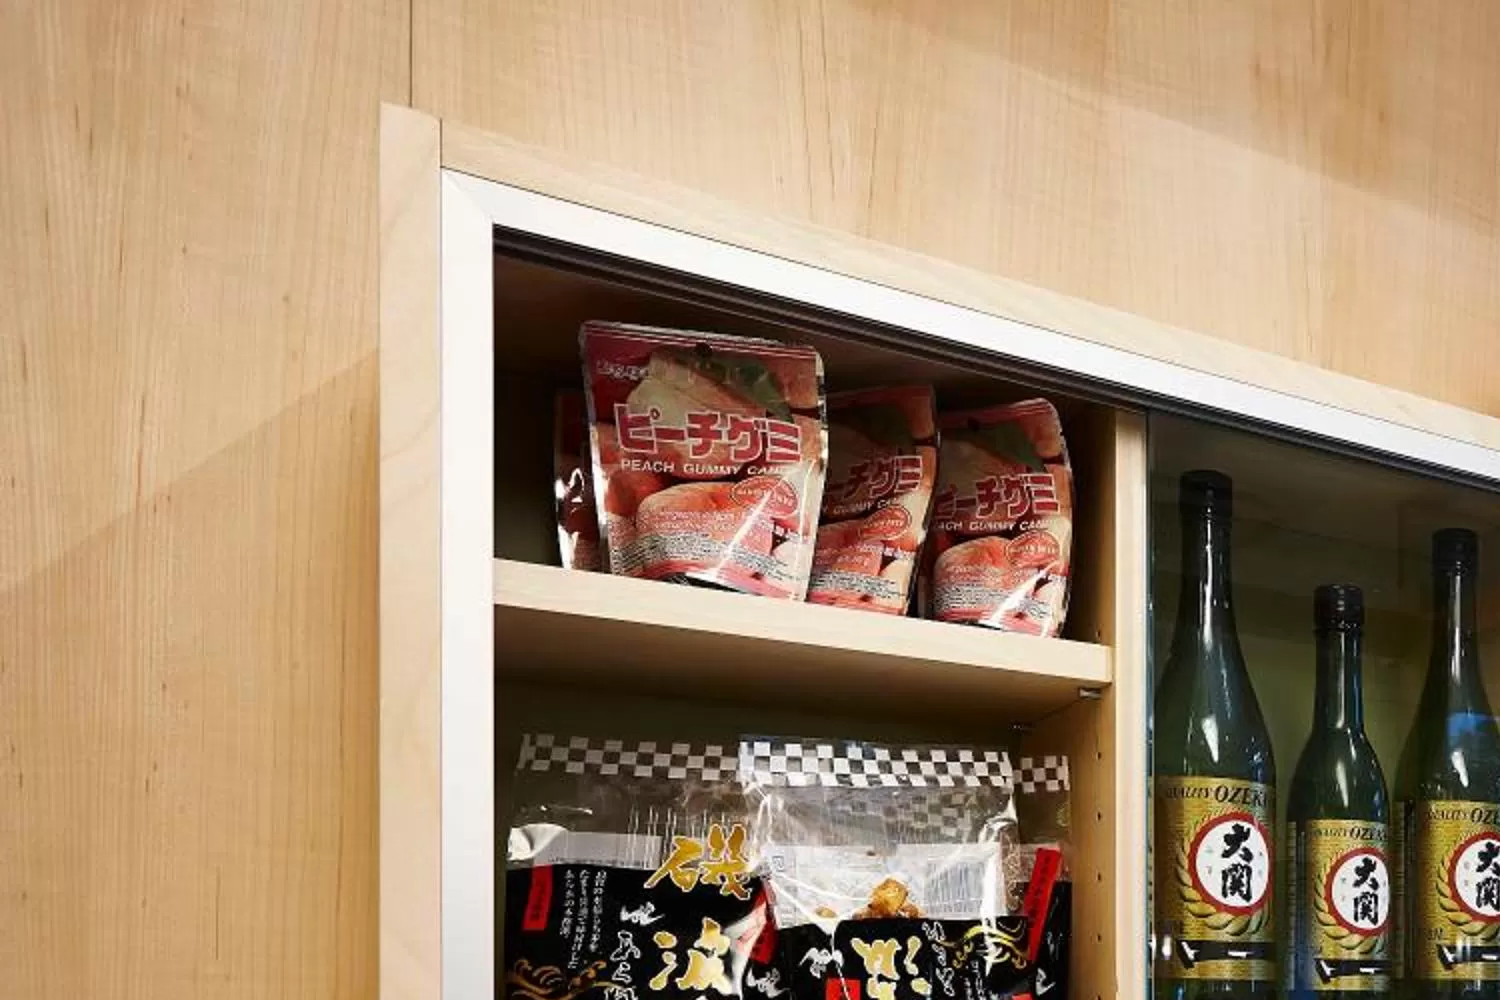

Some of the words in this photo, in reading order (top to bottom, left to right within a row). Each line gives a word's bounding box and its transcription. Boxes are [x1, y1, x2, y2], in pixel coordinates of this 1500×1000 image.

[613, 402, 801, 463] ピーチグミ
[620, 458, 675, 474] PEACH
[683, 464, 742, 477] GUMMY
